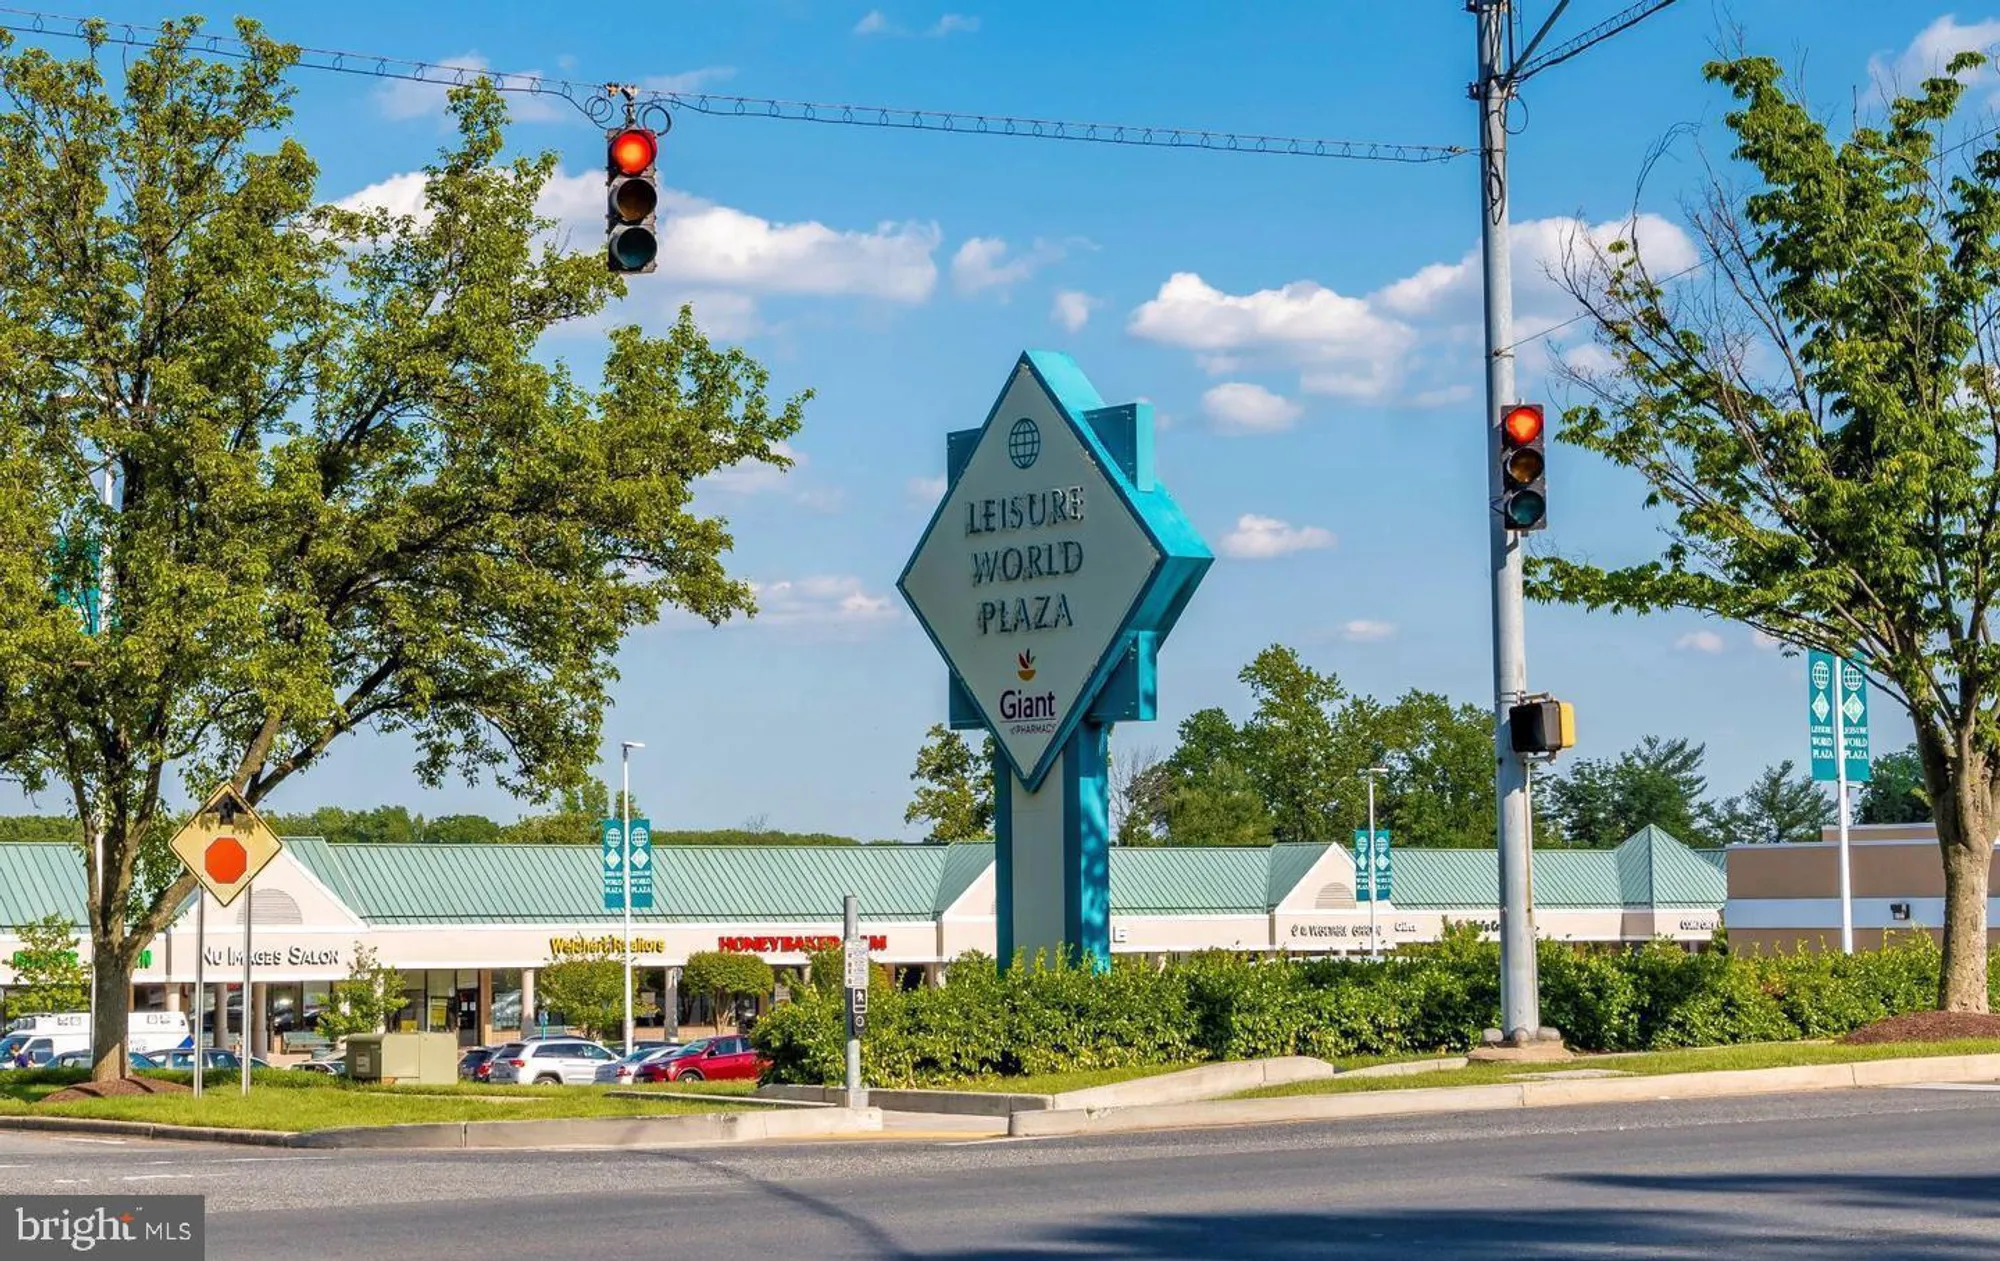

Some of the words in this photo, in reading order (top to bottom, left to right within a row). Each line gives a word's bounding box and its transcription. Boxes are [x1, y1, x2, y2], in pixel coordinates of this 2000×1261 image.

[967, 486, 1084, 536] LEISURE
[971, 540, 1083, 586] WORLD
[979, 594, 1074, 635] PLAZA
[1000, 689, 1056, 719] Giant
[1812, 748, 1834, 759] PLAZA
[1845, 750, 1868, 760] PLAZA
